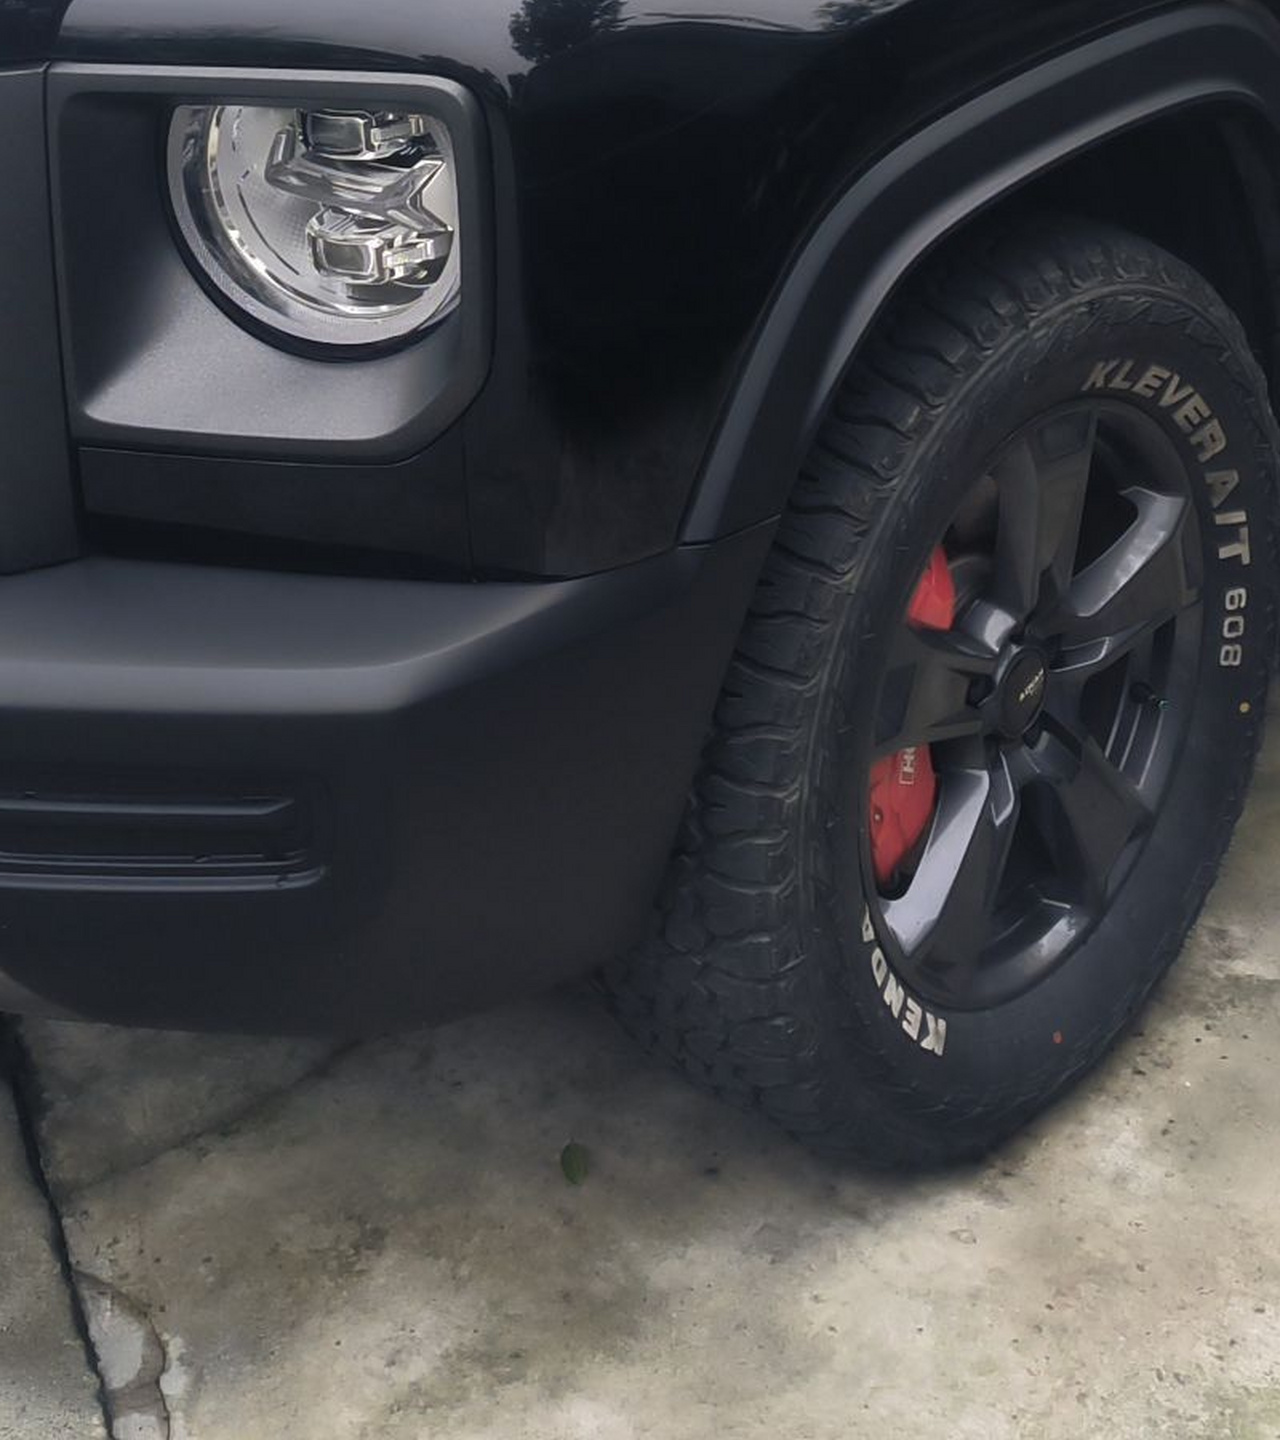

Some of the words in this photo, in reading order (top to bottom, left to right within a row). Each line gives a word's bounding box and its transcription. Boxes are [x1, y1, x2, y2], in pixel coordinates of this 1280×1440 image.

[1081, 358, 1228, 463] KLEVER
[1220, 587, 1247, 667] 608
[861, 901, 948, 1057] KENDA
